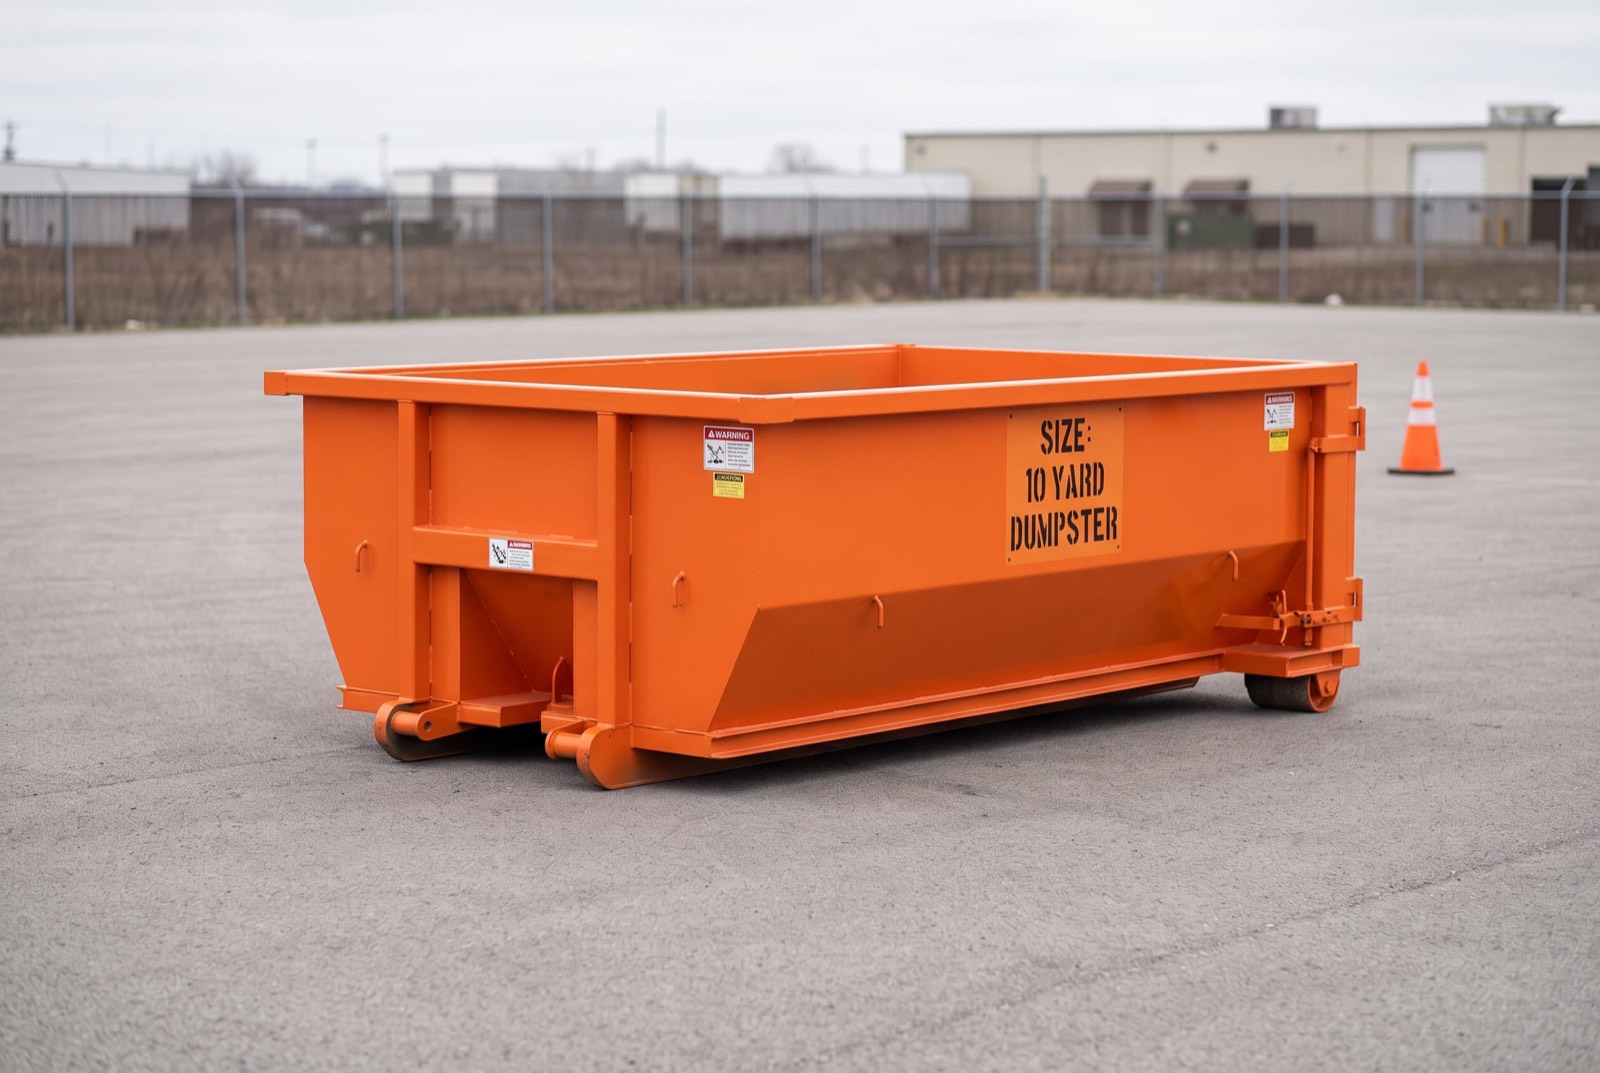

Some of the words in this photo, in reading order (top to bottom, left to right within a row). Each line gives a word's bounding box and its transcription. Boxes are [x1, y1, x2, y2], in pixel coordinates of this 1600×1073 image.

[715, 430, 750, 440] WARNING
[1040, 418, 1091, 455] SIZE:
[1026, 467, 1046, 503] 10
[1052, 462, 1105, 500] YARD
[1011, 506, 1118, 552] DUMPSTER
